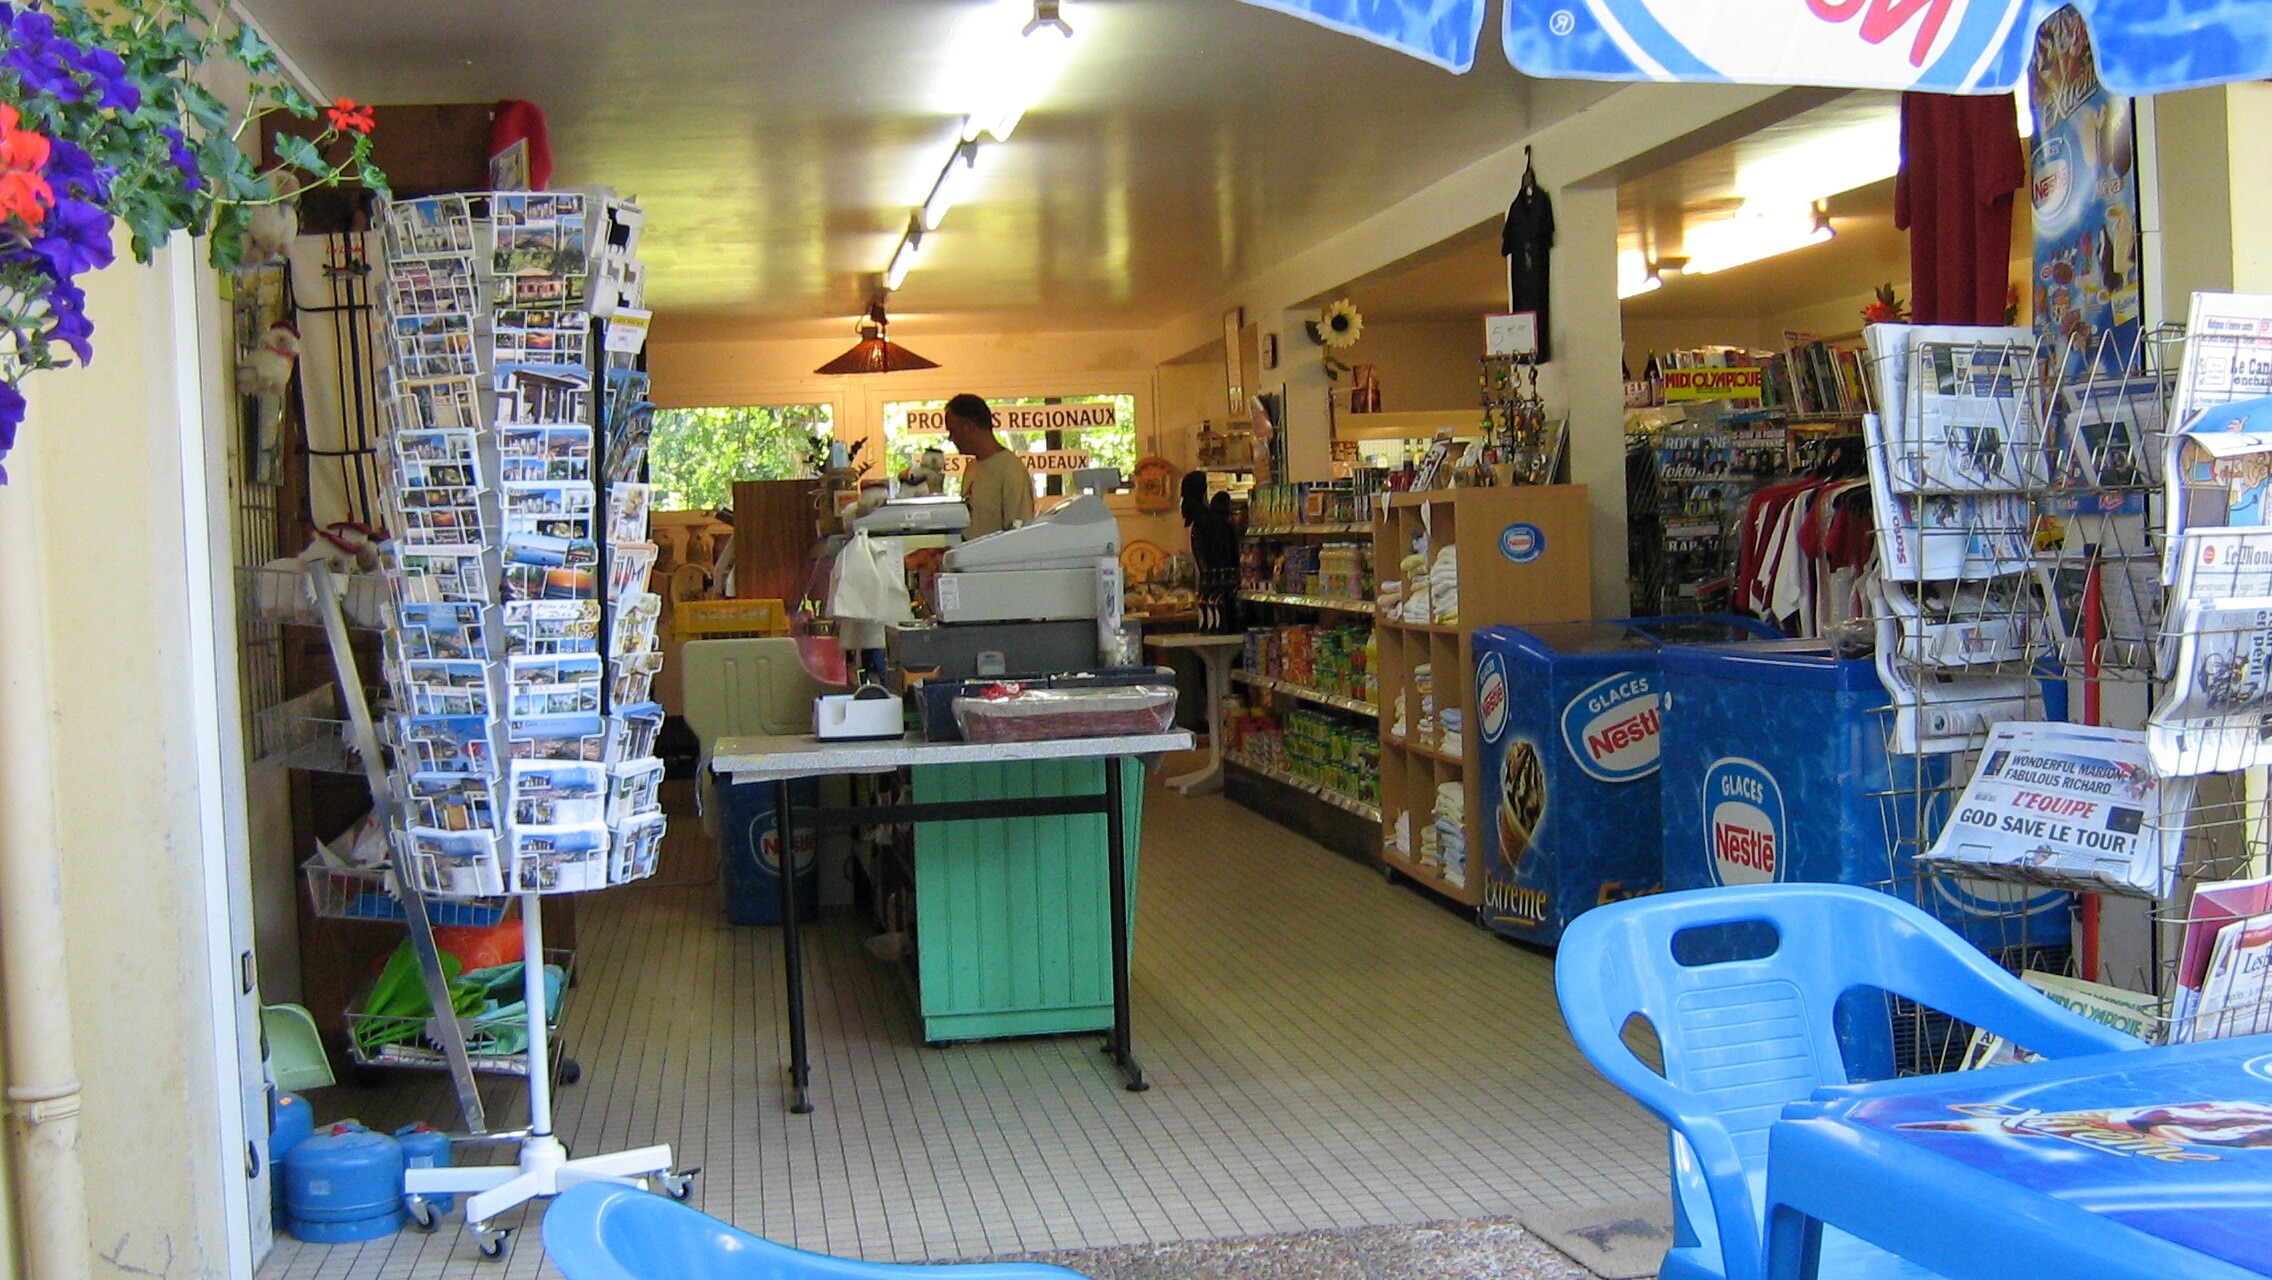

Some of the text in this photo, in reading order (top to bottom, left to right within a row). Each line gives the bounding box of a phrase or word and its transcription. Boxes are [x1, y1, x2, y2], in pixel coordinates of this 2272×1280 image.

[1008, 409, 1115, 428] REGIONAUX
[1588, 677, 1650, 713] GLACES
[2011, 755, 2076, 774] WONDERFUL
[1721, 775, 1763, 804] GLACES
[2003, 769, 2112, 795] FABULOUS RICHARD
[1960, 808, 1998, 828] GOD
[2001, 815, 2050, 838] SAVE
[2049, 824, 2073, 843] LE
[2076, 828, 2127, 854] TOUR
